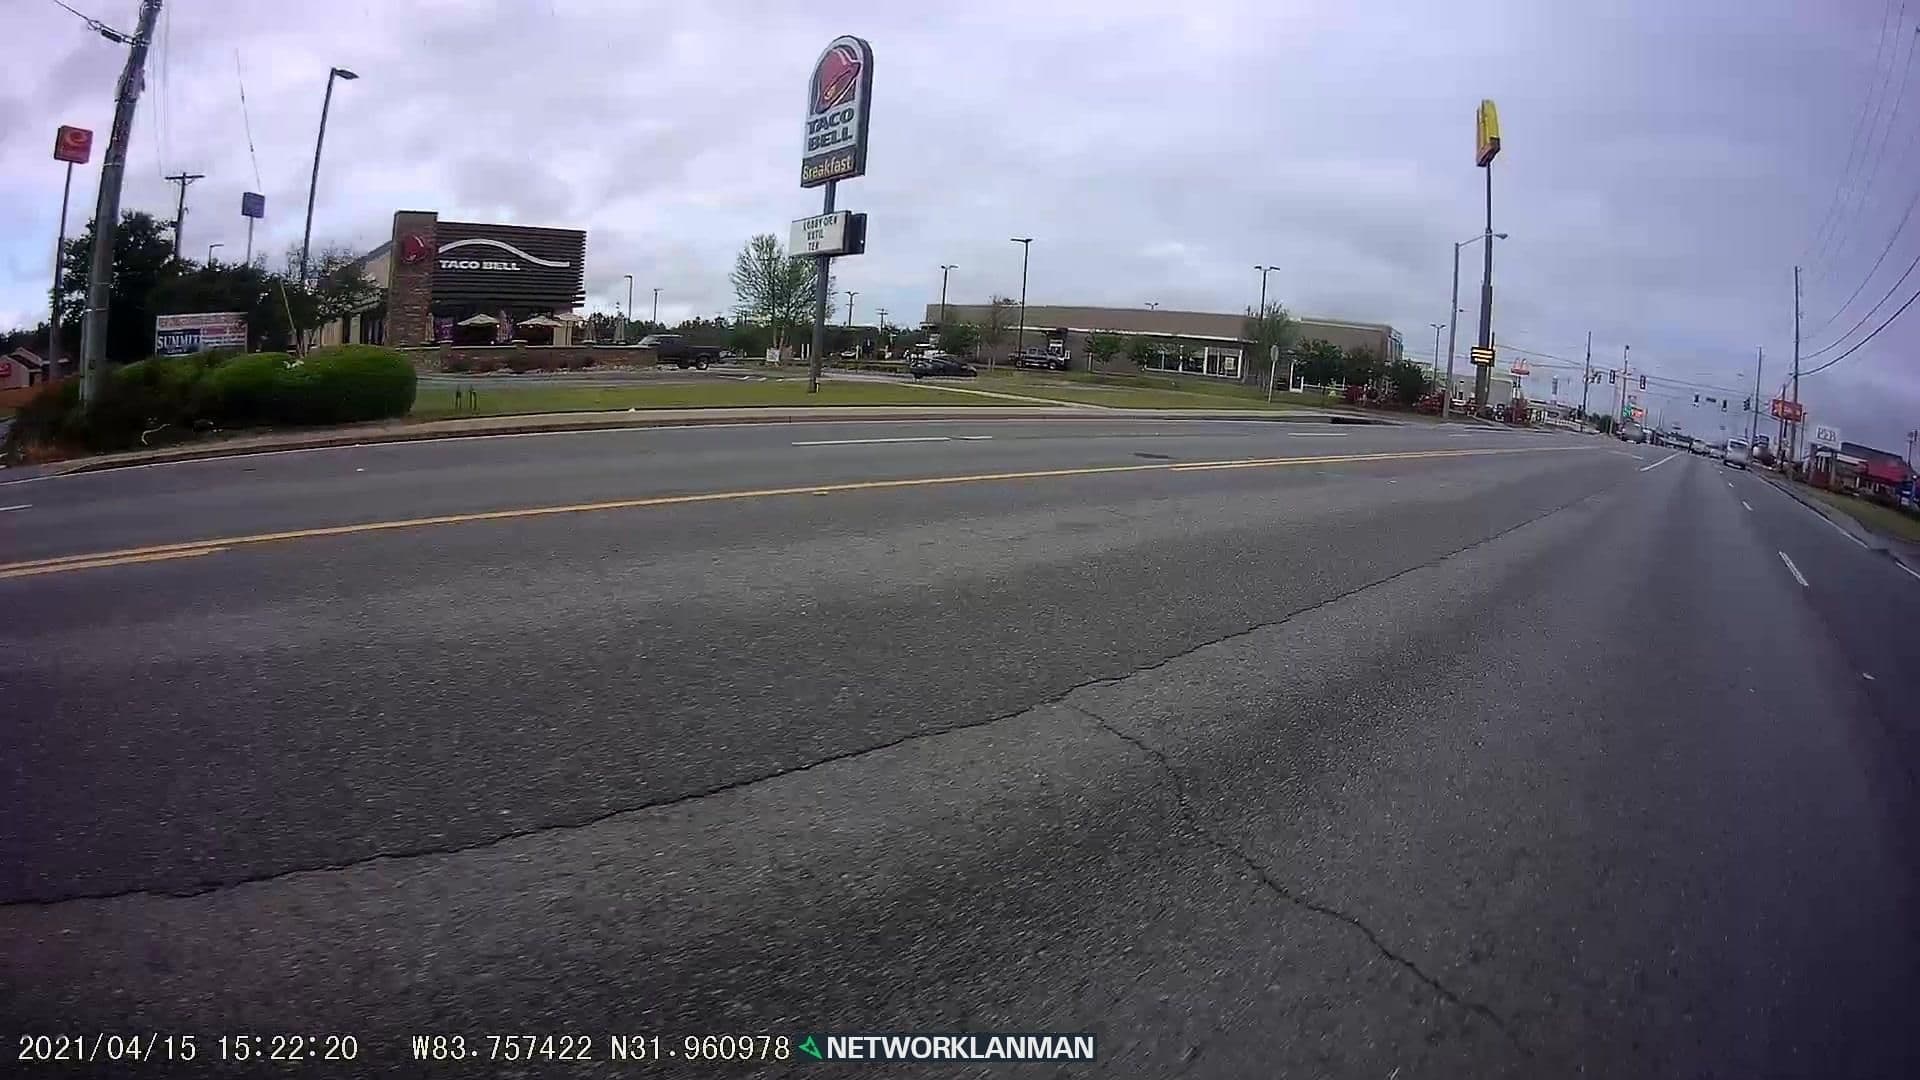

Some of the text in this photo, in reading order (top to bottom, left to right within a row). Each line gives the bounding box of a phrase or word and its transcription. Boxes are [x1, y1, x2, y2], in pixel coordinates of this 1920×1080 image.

[807, 108, 854, 135] TACO
[808, 127, 853, 151] BELL
[802, 155, 853, 180] Breakfast
[440, 260, 521, 271] TACO BELL
[157, 334, 200, 349] SUMMIT
